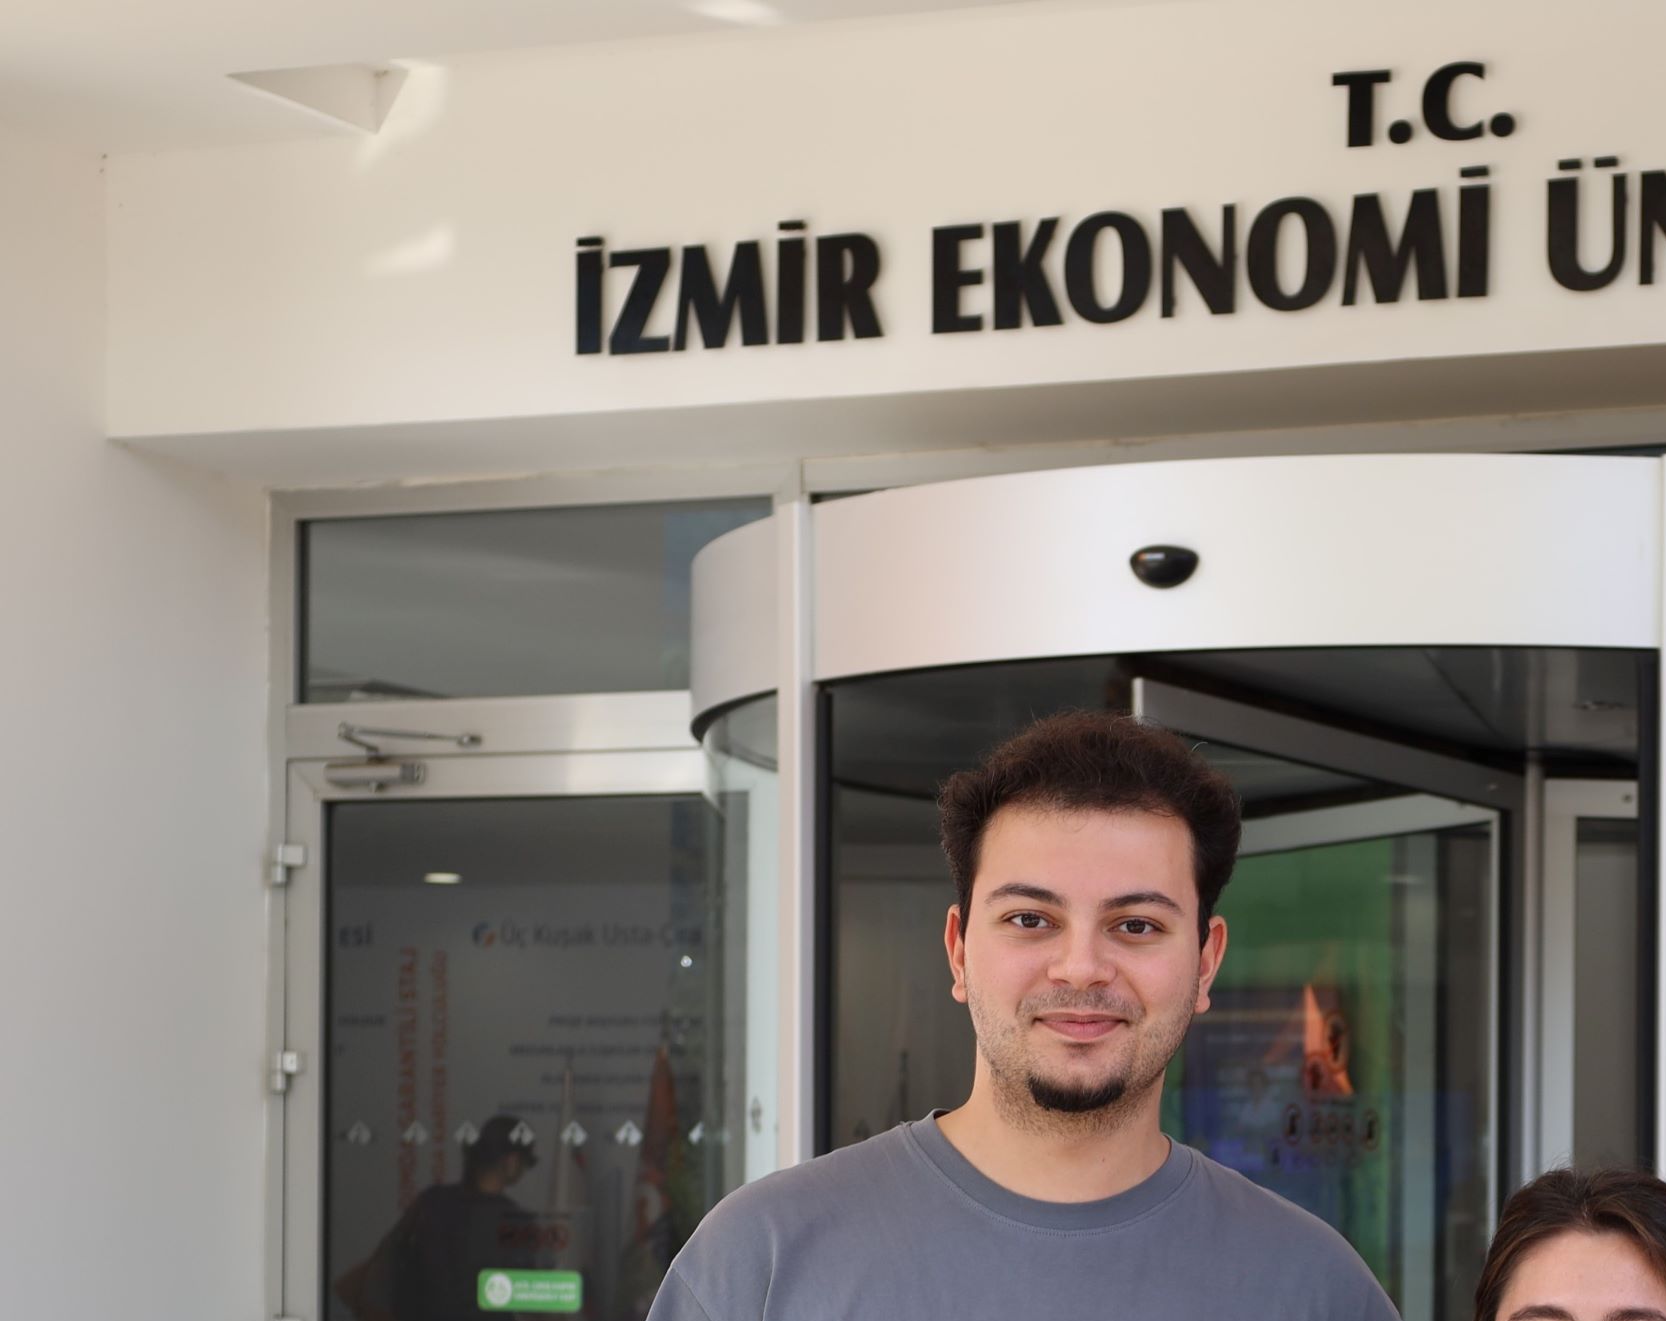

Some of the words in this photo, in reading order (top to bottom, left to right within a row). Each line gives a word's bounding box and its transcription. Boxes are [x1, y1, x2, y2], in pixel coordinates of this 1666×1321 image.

[1331, 62, 1516, 148] T.C.
[574, 219, 884, 356] İZMİR
[931, 166, 1491, 335] EKONOMİ
